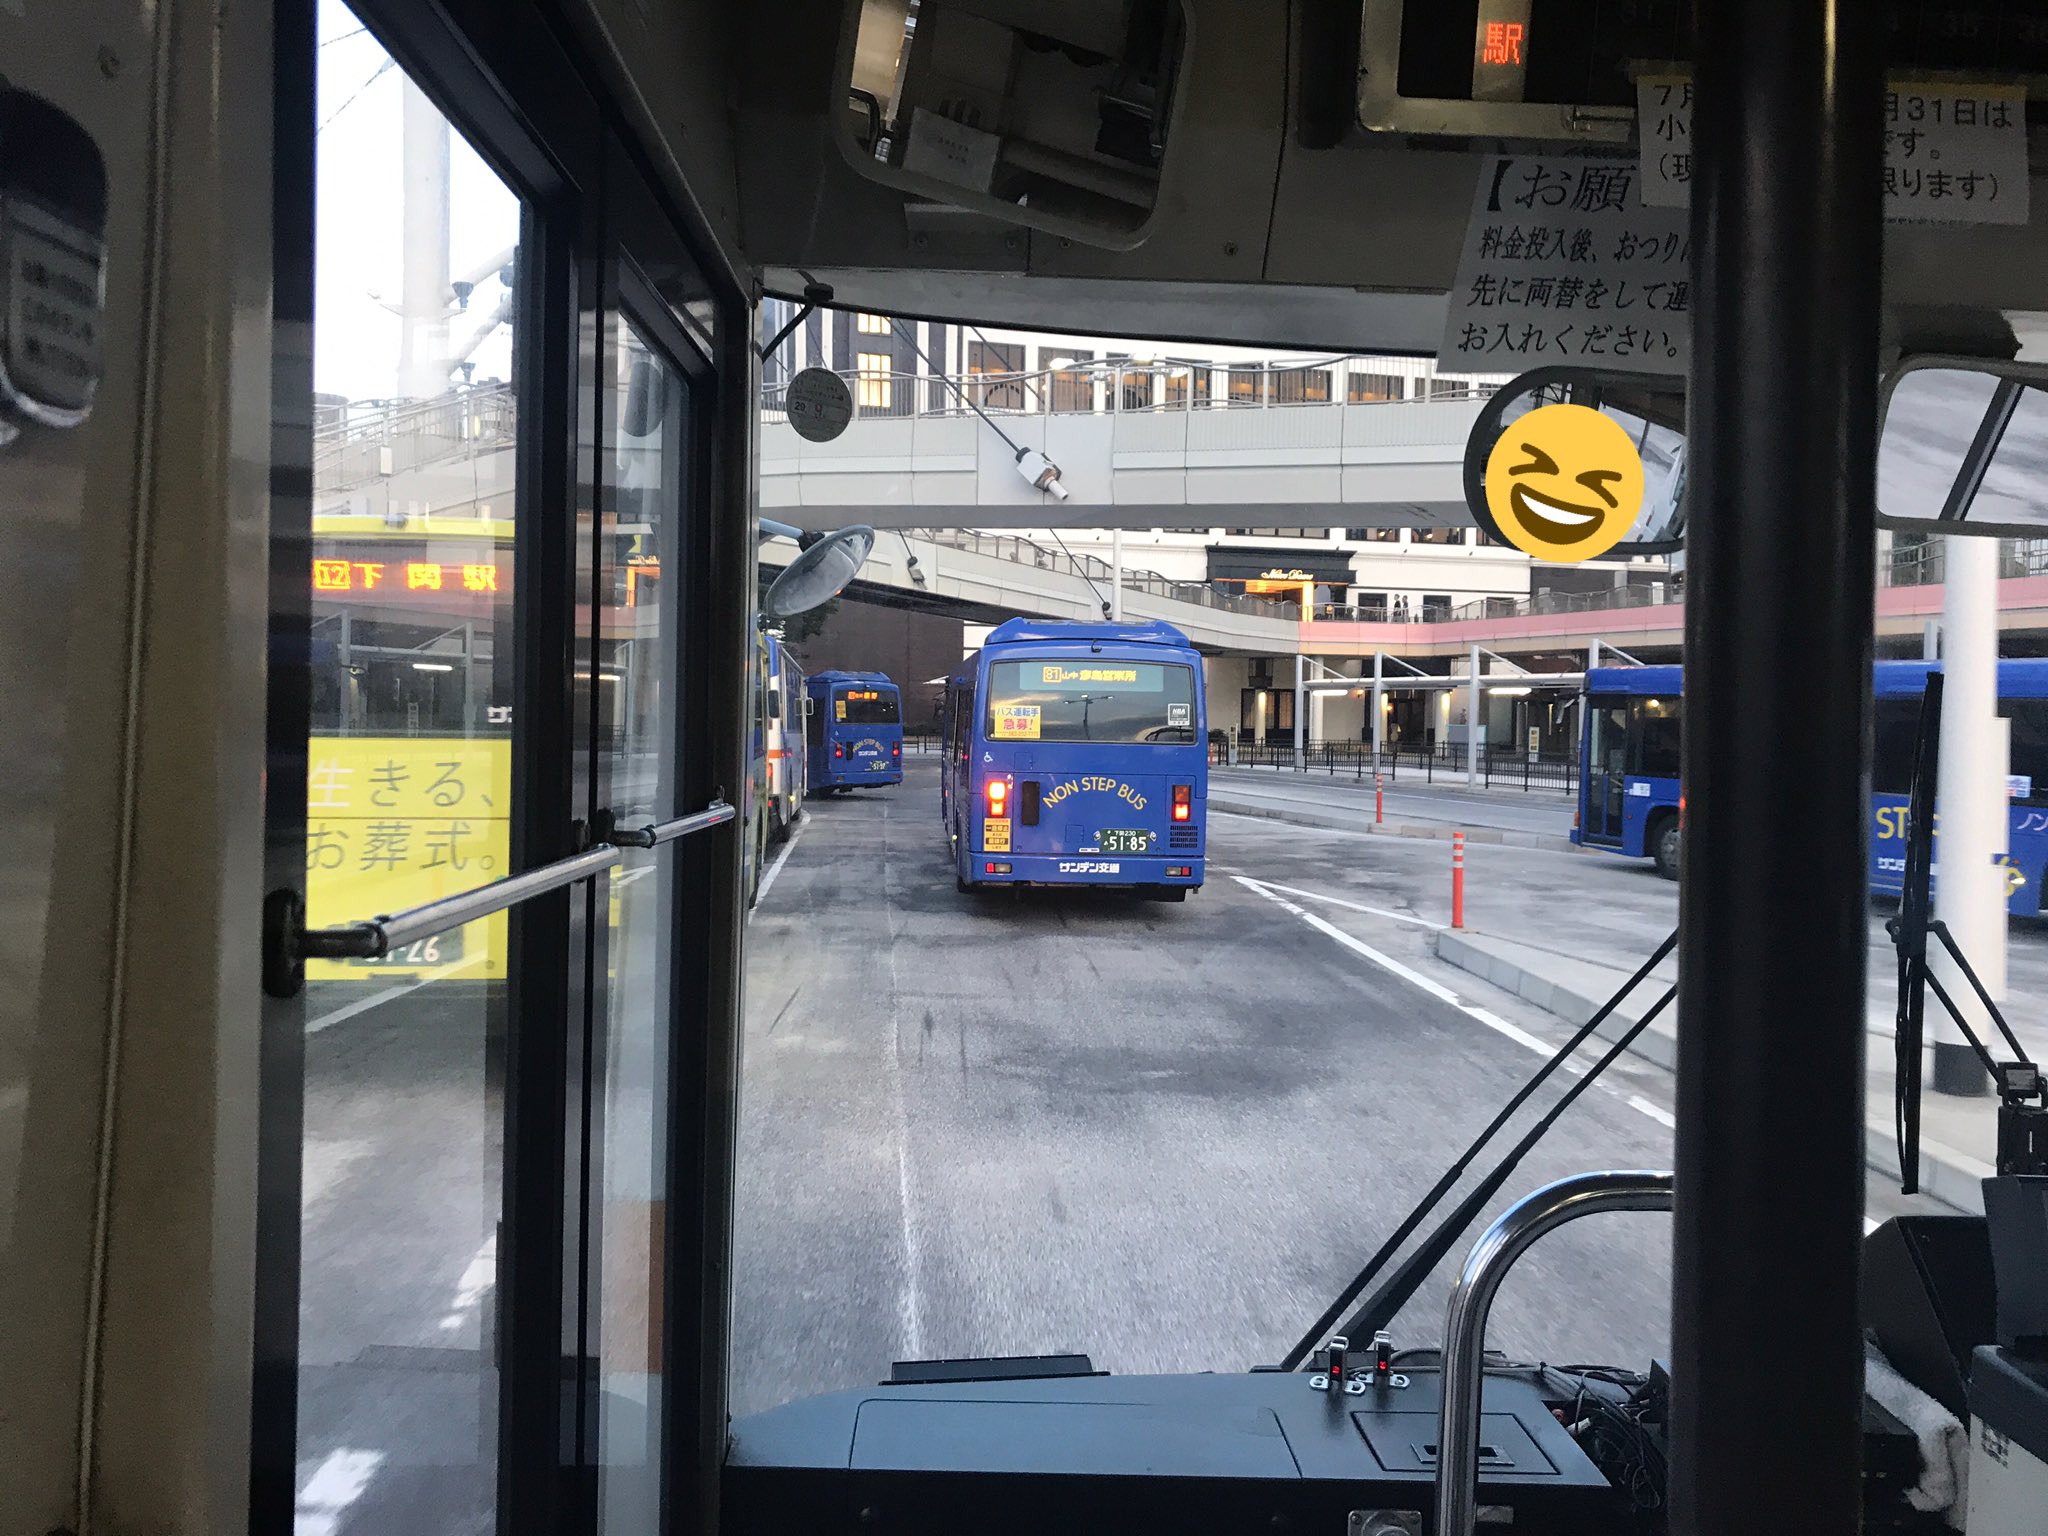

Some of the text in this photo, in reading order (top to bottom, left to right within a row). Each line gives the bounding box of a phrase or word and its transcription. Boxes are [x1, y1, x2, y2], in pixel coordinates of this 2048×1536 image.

[1483, 22, 1524, 65] 駅
[1487, 160, 1647, 213] 【お願
[1458, 322, 1678, 358] お入れください。
[316, 562, 348, 588] 12
[1044, 667, 1060, 681] 81
[996, 706, 1040, 717] バス運転手
[308, 758, 494, 808] 生きる、
[1043, 776, 1148, 810] NON STEP BUS
[306, 821, 495, 872] お葬式。
[1109, 836, 1147, 851] 51-85
